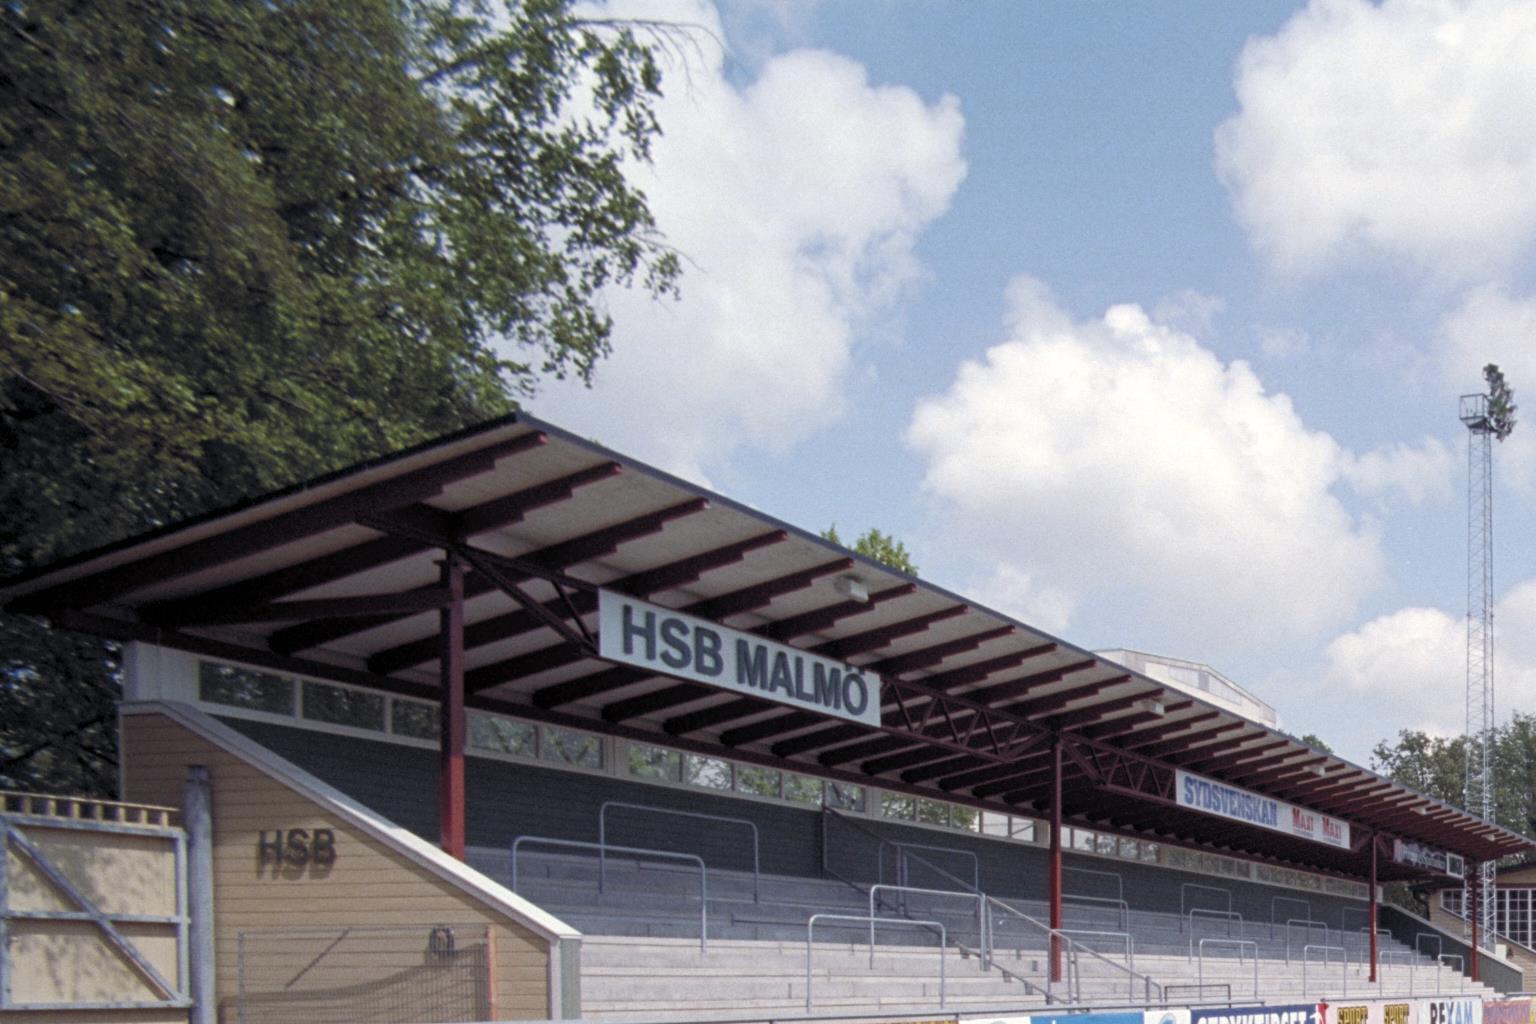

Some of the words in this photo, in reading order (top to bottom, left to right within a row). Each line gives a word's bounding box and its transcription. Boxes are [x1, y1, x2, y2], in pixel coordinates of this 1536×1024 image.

[622, 604, 723, 676] HSB
[736, 638, 868, 716] MALMÖ
[1184, 775, 1277, 827] SYDSVENSKAN
[258, 828, 336, 865] HSB
